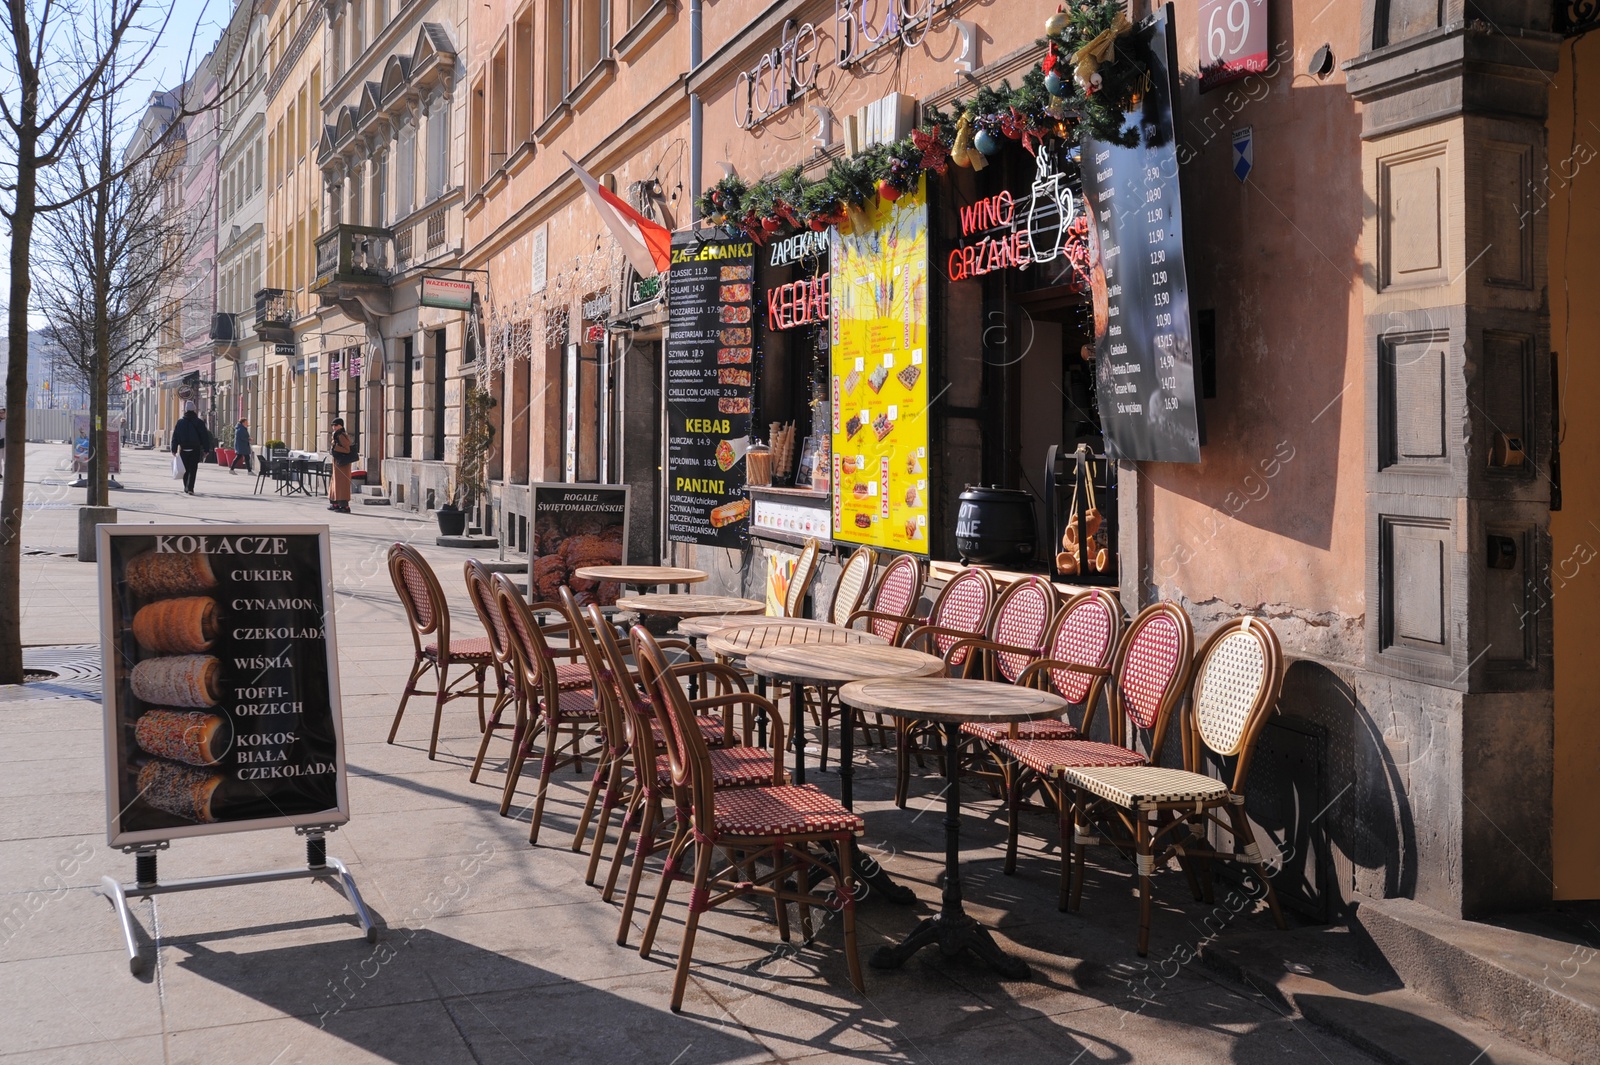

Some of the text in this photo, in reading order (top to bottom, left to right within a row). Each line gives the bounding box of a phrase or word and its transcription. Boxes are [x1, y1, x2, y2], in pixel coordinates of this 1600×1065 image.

[1208, 0, 1250, 61] 69
[1096, 150, 1110, 165] Espresso
[1099, 167, 1160, 202] Americano 9,90
[1100, 188, 1161, 222] Doppio 10,90
[960, 190, 1014, 236] WINO
[1148, 208, 1163, 223] 11,90
[1149, 229, 1164, 244] 11,90
[672, 243, 753, 264] ZAEKANKI
[948, 230, 1030, 281] GRZANE
[1150, 250, 1165, 265] 12,90
[671, 269, 692, 278] CLASSIC
[1152, 271, 1167, 286] 12,90
[426, 280, 470, 289] WAZEKTOMIA
[671, 286, 690, 294] SALAMI
[1154, 292, 1170, 306] 13,90
[670, 307, 703, 315] MOZZARELLA
[1109, 313, 1171, 336] Herbata 10,90
[1110, 334, 1173, 356] Czekolada 13/15
[1112, 356, 1174, 375] Herbata Zimowa 14,90
[1114, 377, 1176, 394] Grzane Wino 14/22
[1117, 402, 1125, 413] Sok
[1165, 397, 1179, 411] 16,90
[686, 419, 730, 434] KEBAB
[670, 457, 700, 465] WOŁOWINA
[676, 477, 724, 494] PANINI
[537, 502, 624, 513] ŚWIĘTOMARCIŃSKIE
[155, 535, 288, 555] KOŁACZE
[670, 534, 698, 543] vegetables
[231, 570, 293, 582] CUKIER
[232, 599, 312, 611] CYNAMON
[233, 628, 326, 640] CZEKOLADA
[234, 655, 293, 670] WIŚNIA
[235, 687, 288, 700] TOFFI-
[235, 702, 303, 716] ORZECH
[237, 732, 300, 747] KOKOS-
[237, 750, 287, 764] BIAŁA
[237, 763, 336, 781] CZEKOLADA
